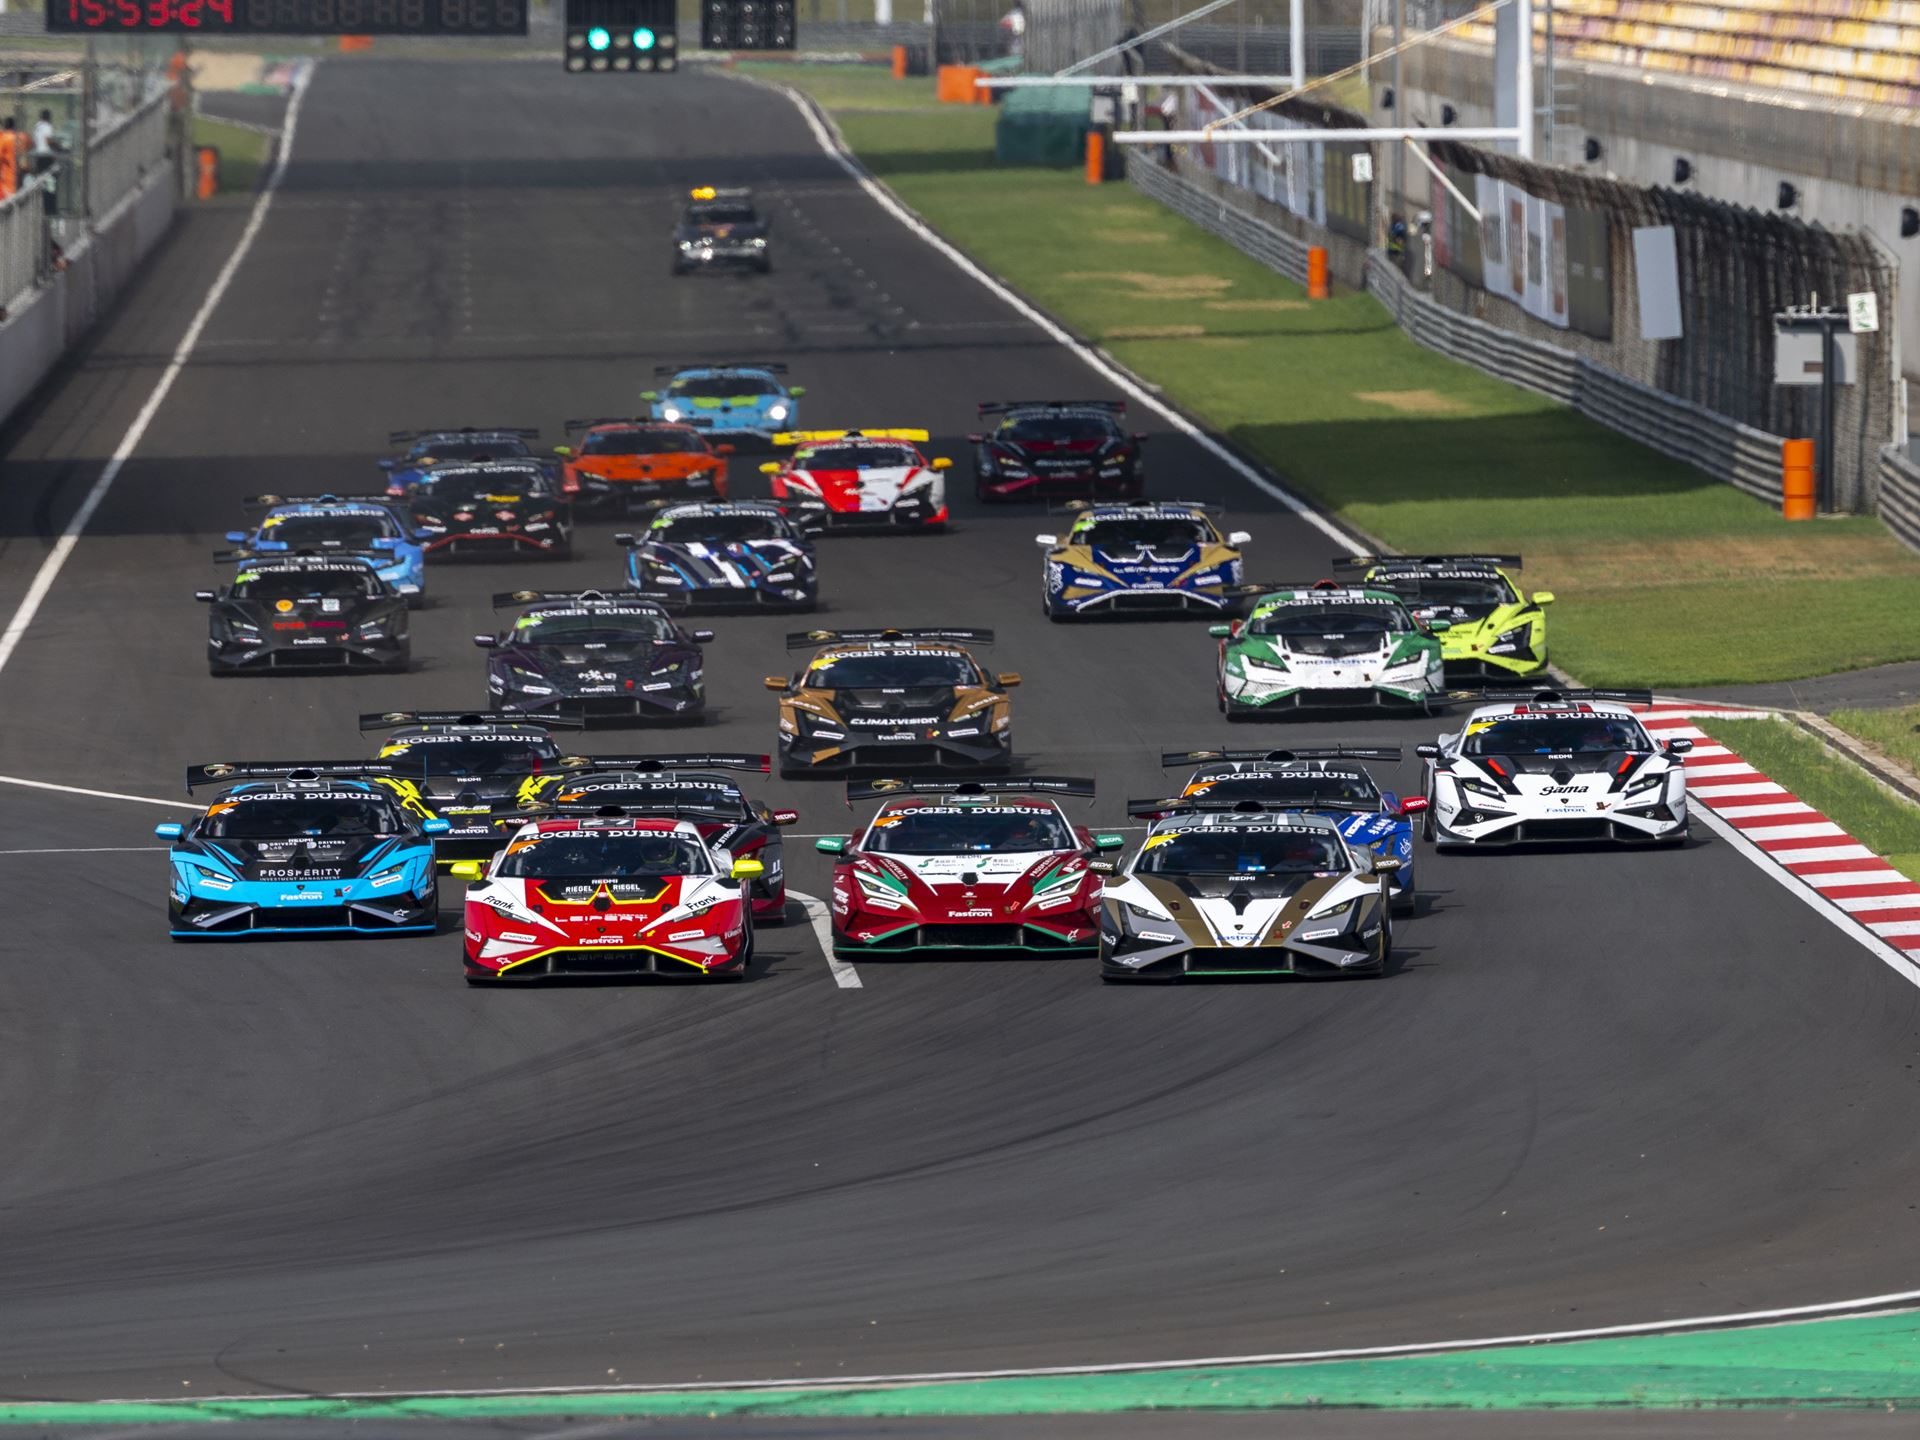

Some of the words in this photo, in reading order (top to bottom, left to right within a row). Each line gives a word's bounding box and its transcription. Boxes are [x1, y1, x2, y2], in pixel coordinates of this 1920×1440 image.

[530, 608, 589, 618] ROGER
[824, 650, 886, 659] ROGER
[893, 649, 960, 658] DUBUIS
[850, 717, 938, 726] CLIMAXVISION
[1481, 713, 1549, 723] ROGER
[1556, 712, 1629, 721] DUBUIS
[396, 735, 463, 745] ROGER
[470, 734, 543, 743] DUBUIS
[1201, 772, 1273, 782] ROGER
[1281, 771, 1359, 780] DUBUIS
[571, 783, 643, 794] ROGER
[651, 782, 728, 791] DUBUIS
[1539, 785, 1589, 796] gama
[224, 793, 296, 803] ROGER
[304, 791, 382, 801] DUBUIS
[888, 807, 963, 816] ROGER
[971, 806, 1052, 815] DUBUIS
[583, 818, 630, 826] 27
[1163, 825, 1238, 835] ROGER
[1246, 824, 1330, 835] DUBUIS
[524, 831, 599, 841] ROGER
[608, 830, 690, 840] DUBUIS
[1090, 861, 1113, 869] REDMI
[1376, 859, 1400, 868] REDMI
[260, 868, 341, 878] PROSPERITY
[565, 885, 593, 893] RIEGEL
[280, 893, 323, 901] Fastron
[555, 913, 649, 922] LEIPERT
[579, 937, 624, 945] Fastron
